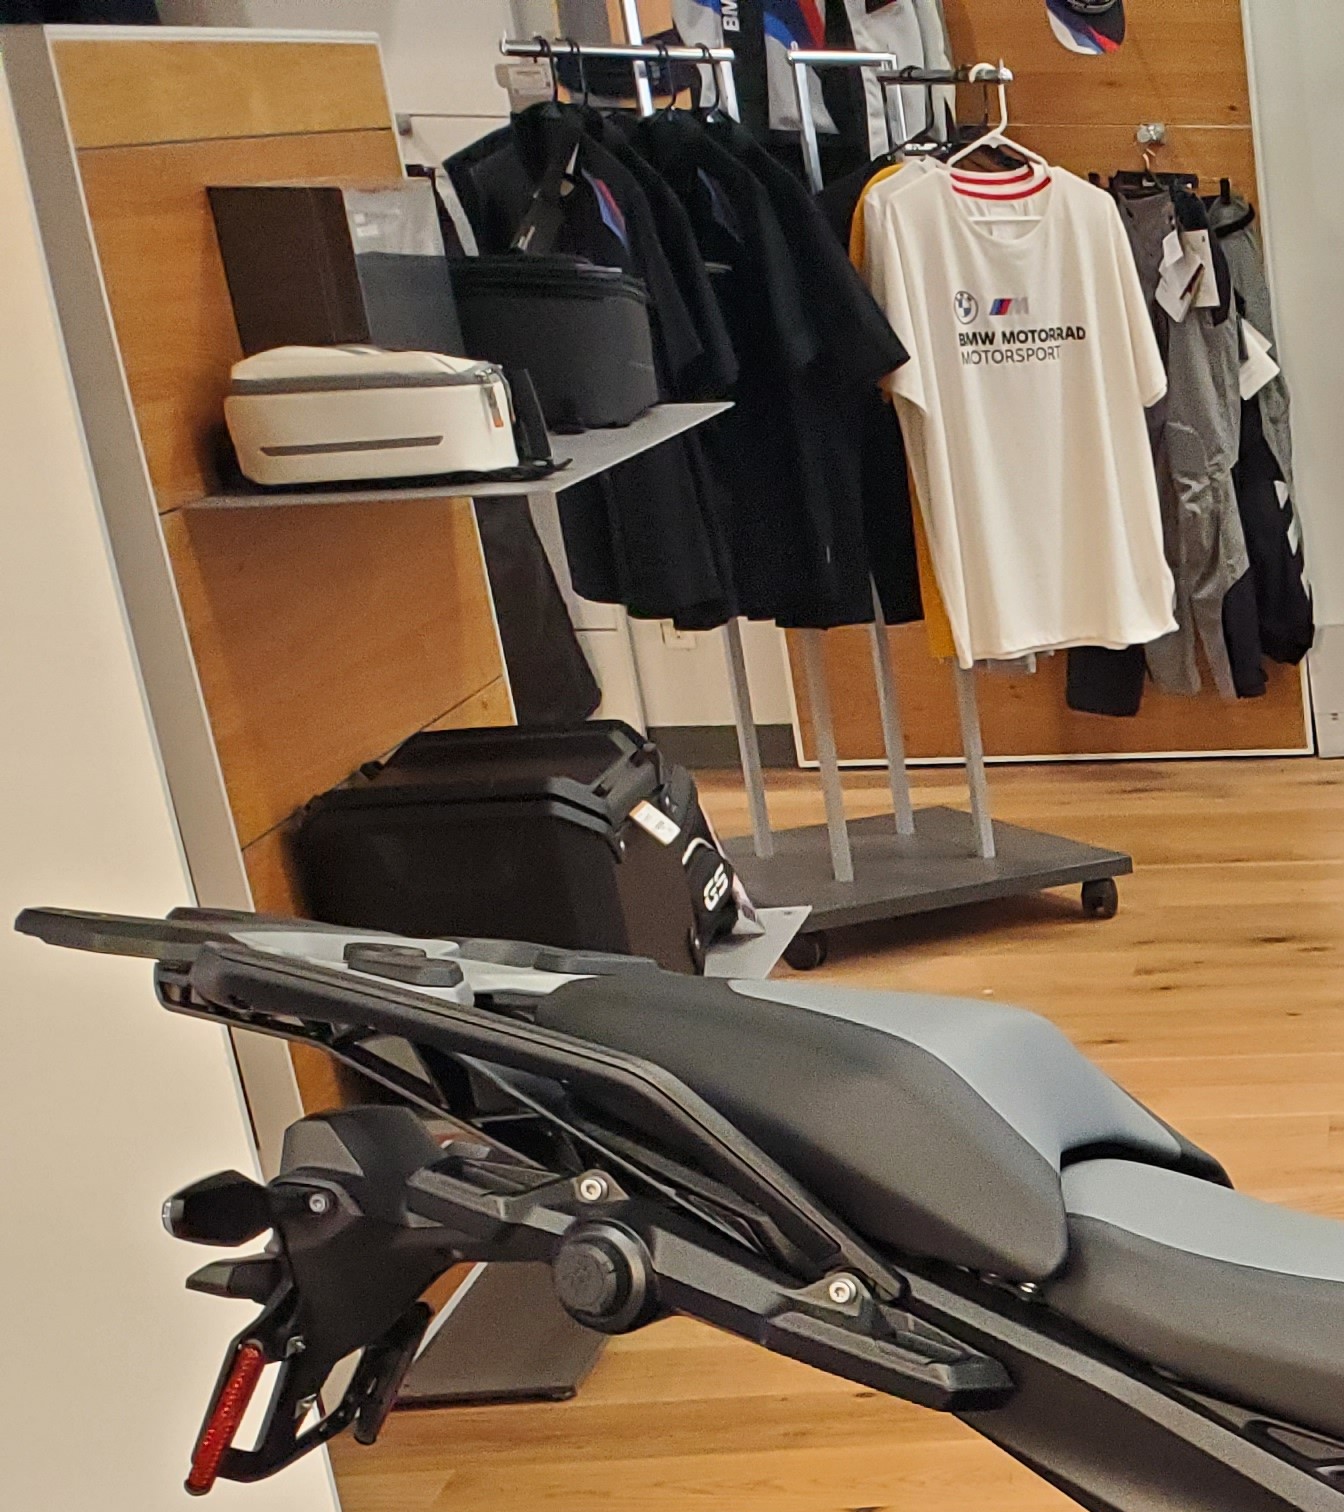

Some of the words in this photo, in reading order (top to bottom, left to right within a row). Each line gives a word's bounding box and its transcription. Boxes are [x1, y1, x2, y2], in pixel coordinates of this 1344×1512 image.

[958, 331, 996, 346] BMW
[1002, 326, 1086, 345] MOTORRAD
[961, 345, 1061, 365] MOTORSPORT
[703, 863, 729, 911] GS
